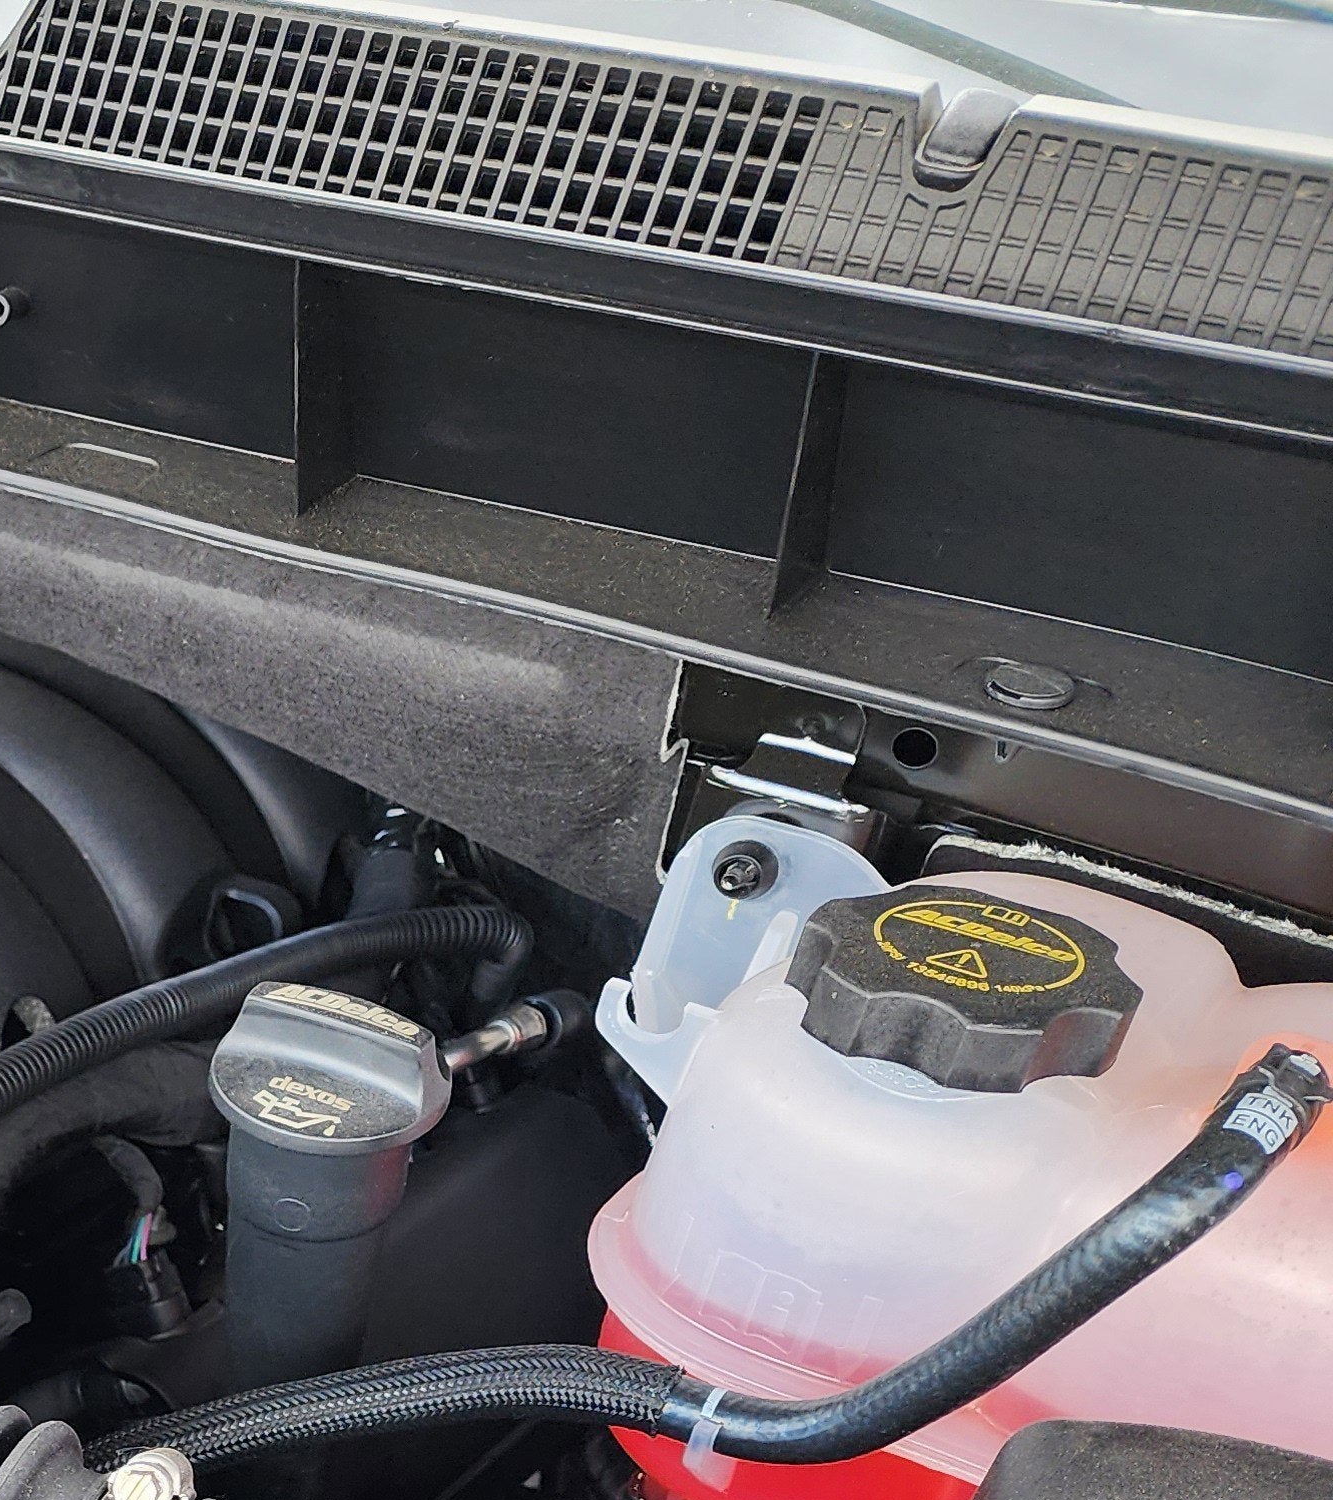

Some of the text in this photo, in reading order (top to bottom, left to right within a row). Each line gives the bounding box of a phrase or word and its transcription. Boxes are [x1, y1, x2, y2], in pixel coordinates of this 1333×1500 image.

[893, 909, 1077, 962] ACDelco
[263, 984, 420, 1042] ACDelco
[268, 1075, 356, 1112] dexos
[1231, 1113, 1279, 1148] ENG
[1249, 1096, 1293, 1130] TNK
